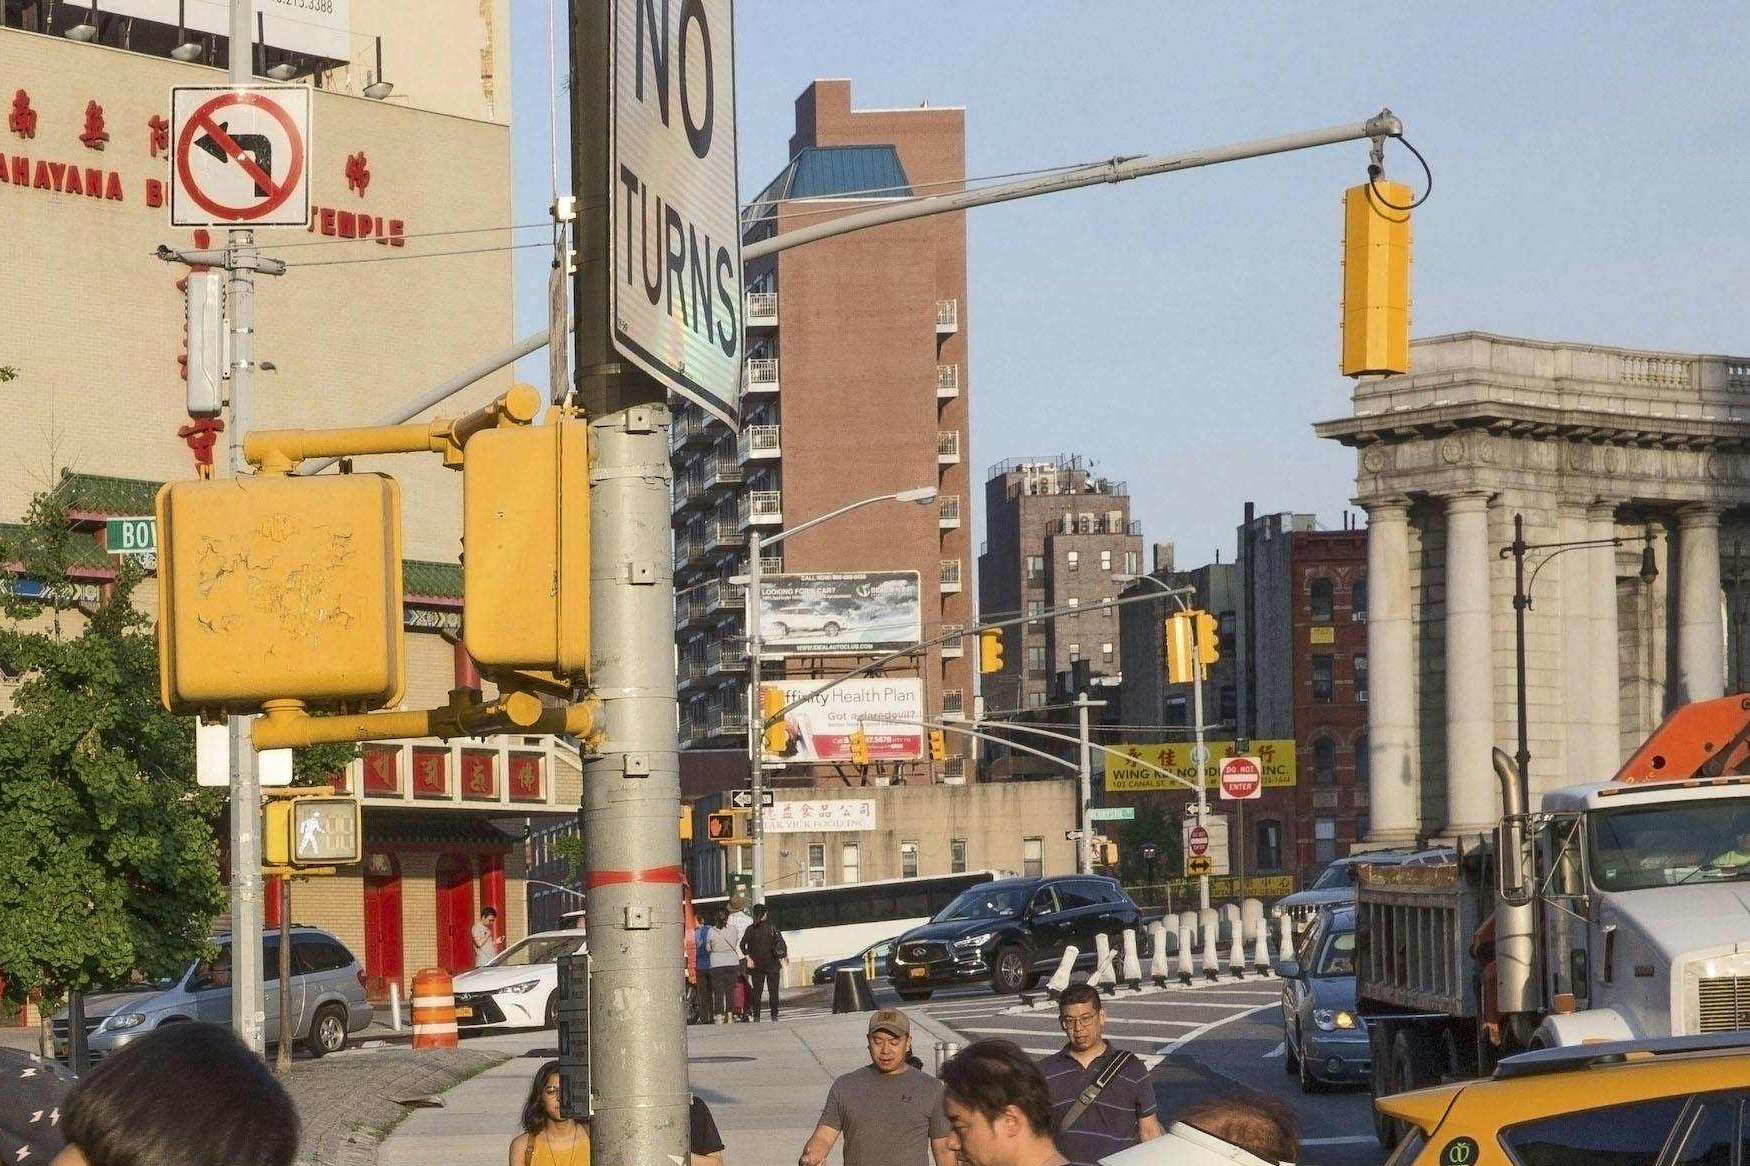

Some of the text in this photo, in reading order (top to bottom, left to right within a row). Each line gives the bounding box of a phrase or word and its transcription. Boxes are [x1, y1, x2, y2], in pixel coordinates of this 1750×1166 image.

[636, 0, 713, 159] NO
[621, 163, 737, 357] TURNS
[762, 588, 793, 596] LOOKING
[832, 688, 881, 702] Health
[884, 687, 915, 702] Plan
[828, 711, 847, 720] Got
[1240, 765, 1255, 773] NOT
[1113, 769, 1150, 779] WING
[814, 818, 843, 827] FOOD
